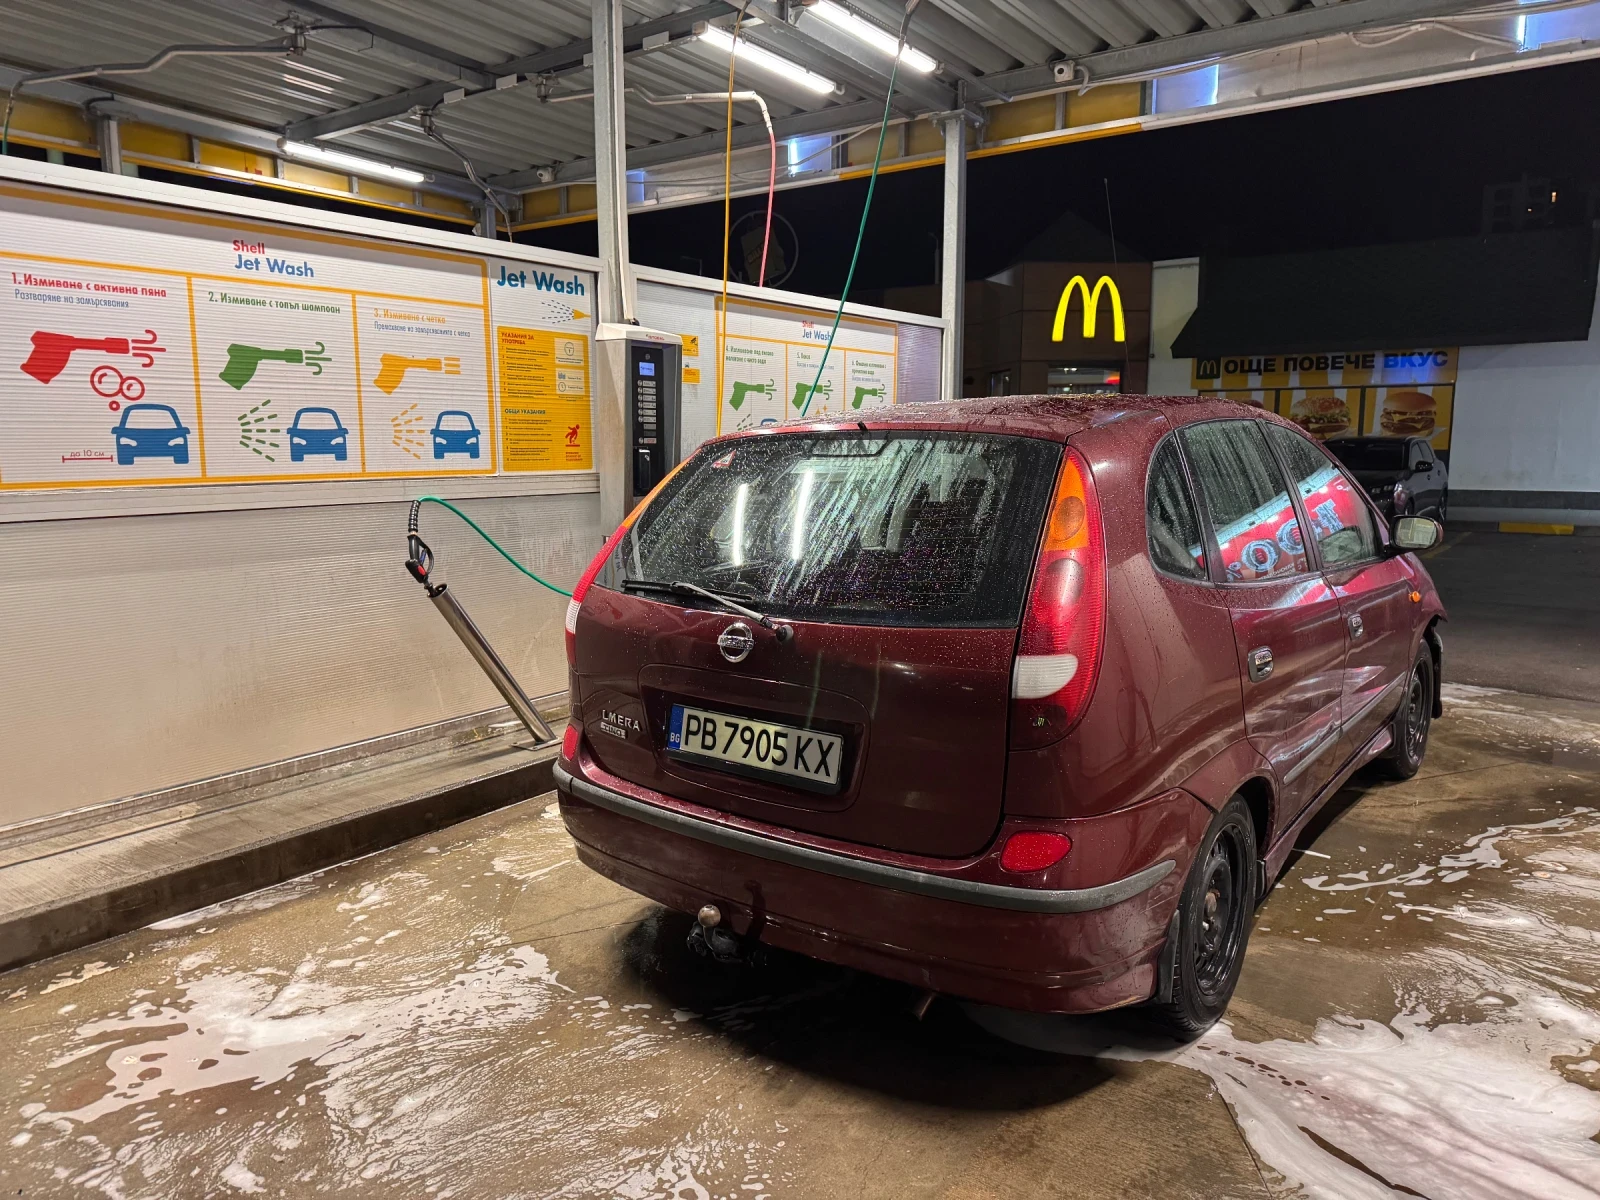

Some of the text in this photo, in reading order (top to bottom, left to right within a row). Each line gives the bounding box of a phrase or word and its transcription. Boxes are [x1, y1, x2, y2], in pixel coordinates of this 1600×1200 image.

[232, 239, 266, 255] Shell
[234, 253, 315, 278] Jet Wash
[11, 271, 22, 285] 1.
[23, 273, 83, 290] Измиване
[94, 284, 138, 295] активна
[141, 287, 167, 298] пяна
[496, 265, 585, 296] Jet Wash
[14, 288, 130, 309] Разтваряне на замърсявания
[208, 291, 218, 302] 2.
[220, 292, 267, 307] Измиване
[274, 301, 300, 310] топъл
[301, 304, 341, 314] шампоан
[802, 329, 812, 339] Jet
[1224, 350, 1448, 376] ОЩЕ ПОВЕЧЕ ВКУС
[83, 449, 93, 457] 10
[669, 732, 681, 743] BG
[684, 714, 835, 777] PB 7905 KX
